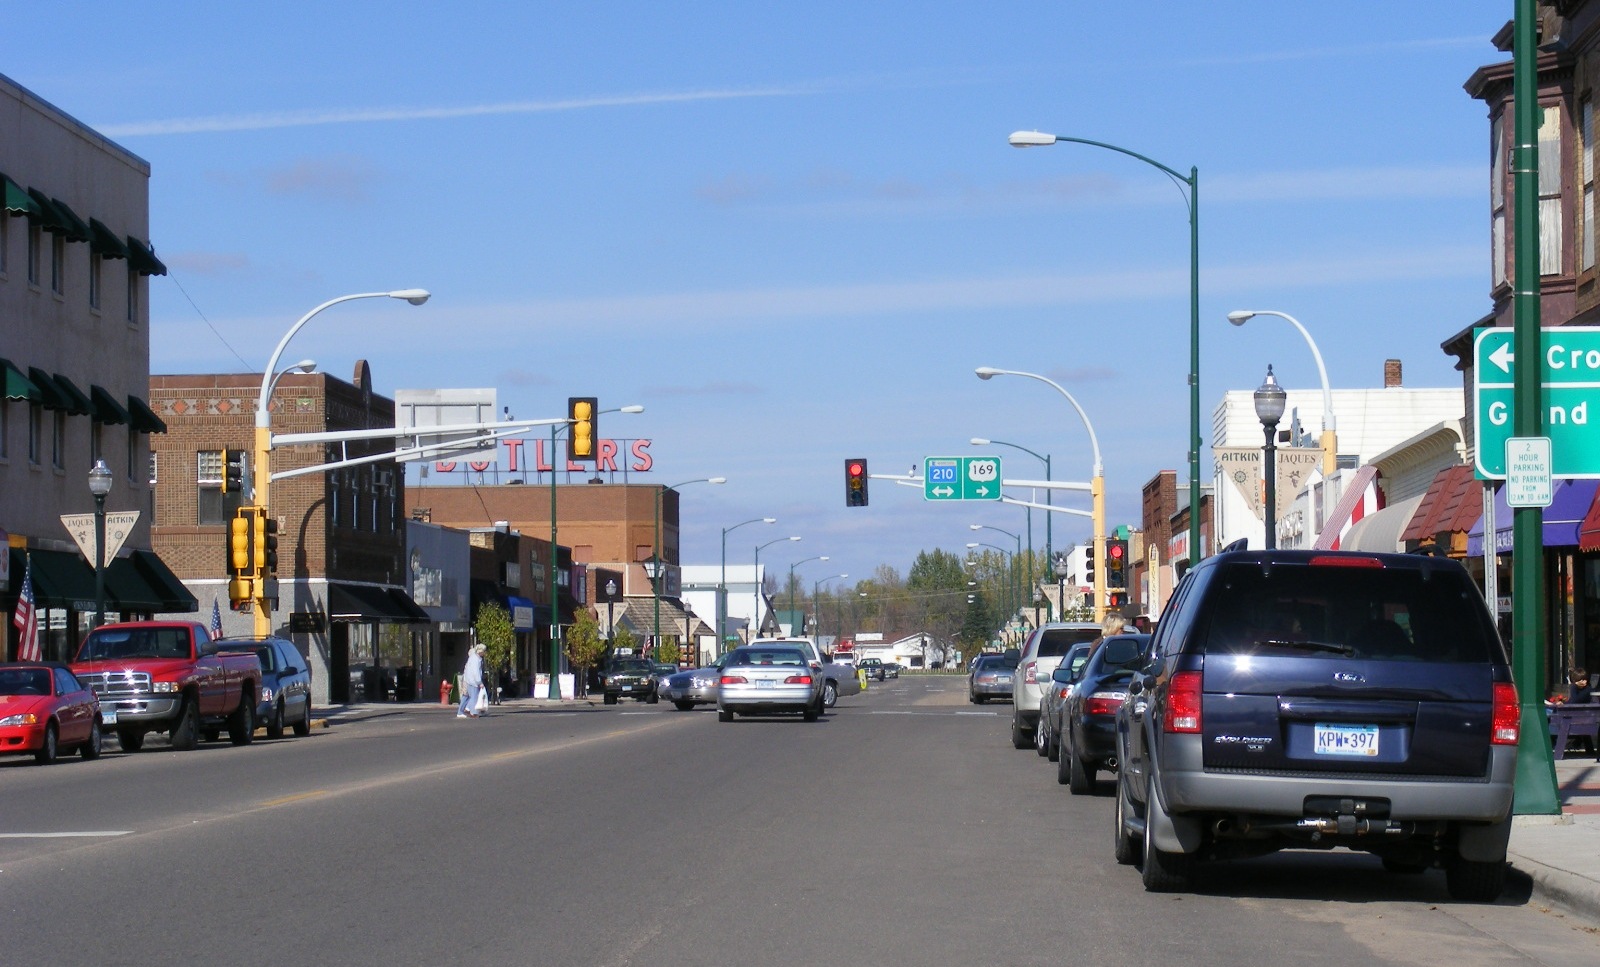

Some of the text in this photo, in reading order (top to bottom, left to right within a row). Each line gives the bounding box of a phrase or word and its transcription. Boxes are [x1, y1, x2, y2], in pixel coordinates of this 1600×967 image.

[1488, 401, 1587, 426] Gnd
[1525, 443, 1531, 452] 2
[1221, 452, 1260, 462] AITKIN
[1278, 453, 1317, 465] JAQUES
[1518, 454, 1539, 462] HOUR
[973, 464, 994, 475] 169
[1513, 464, 1545, 472] PARKING
[932, 468, 954, 480] 210
[1511, 475, 1548, 484] NO PARKING
[67, 518, 95, 528] JAQUES
[107, 516, 135, 525] AITKIN
